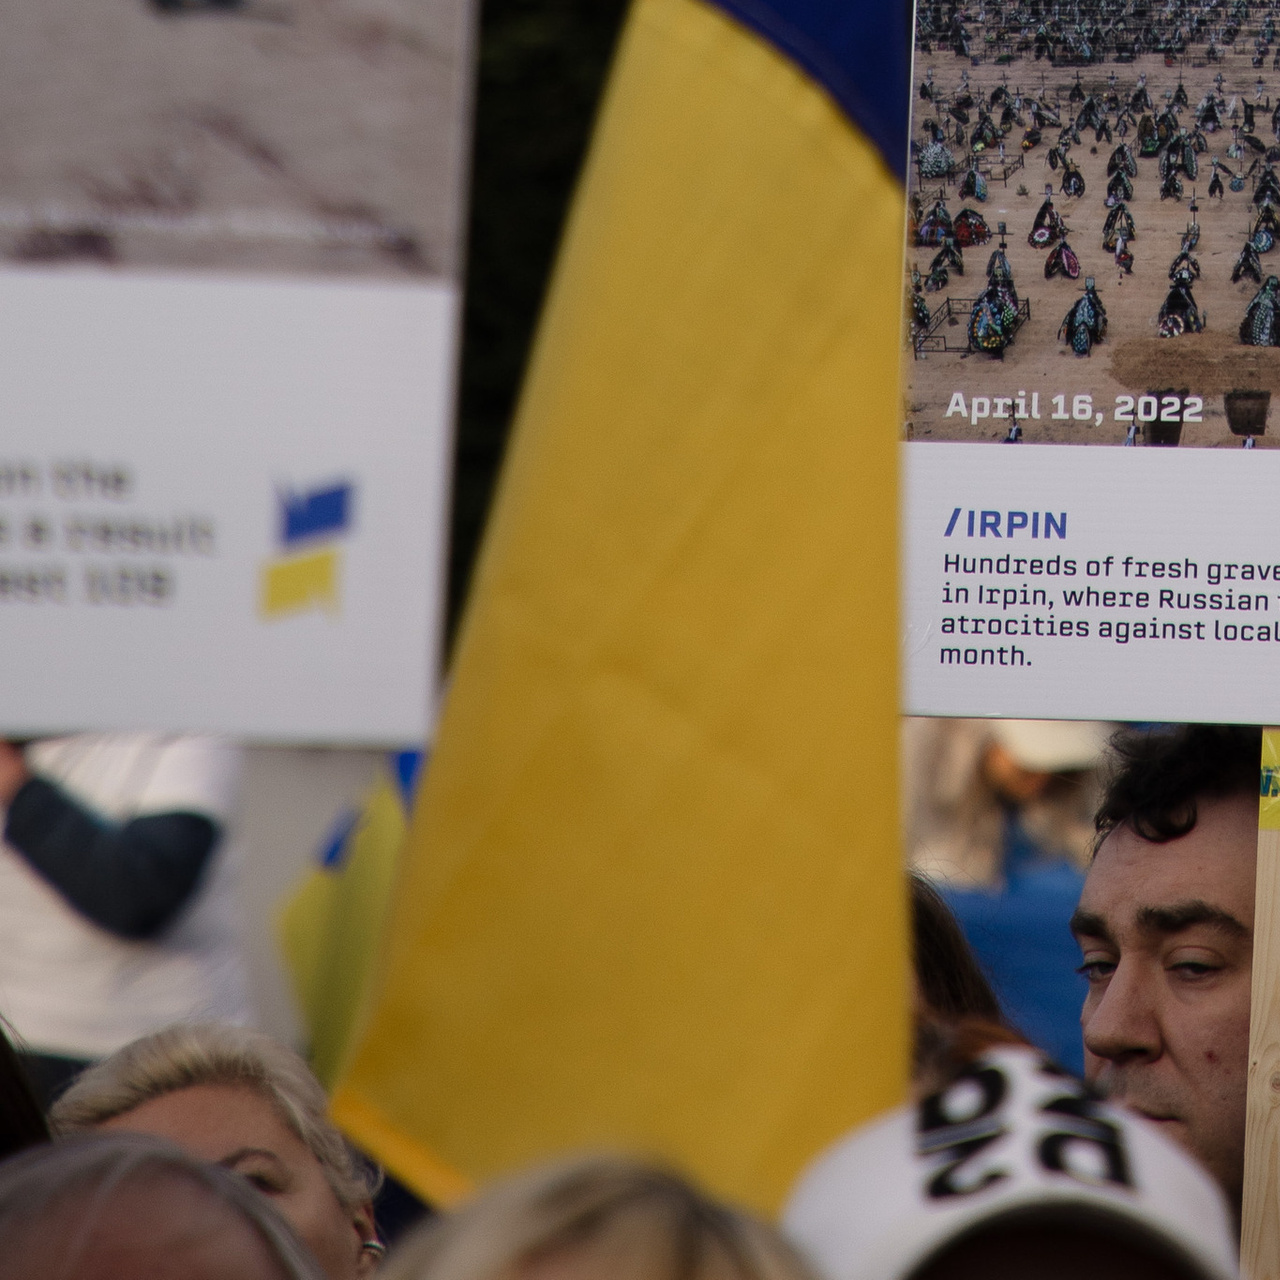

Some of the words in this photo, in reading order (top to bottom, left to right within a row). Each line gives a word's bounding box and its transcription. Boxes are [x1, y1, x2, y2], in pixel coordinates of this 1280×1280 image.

[945, 390, 1041, 425] April
[1051, 394, 1104, 427] 16,
[1113, 395, 1203, 423] 2022
[944, 507, 1067, 539] /IRPIN
[944, 553, 1077, 576] Hundreds
[1086, 555, 1114, 577] of
[1121, 556, 1198, 579] fresh
[942, 581, 969, 604] in
[978, 583, 1054, 611] Irpin,
[1062, 586, 1150, 608] where
[1159, 588, 1269, 611] Russian
[941, 613, 1090, 637] atrocities
[1098, 617, 1206, 644] against
[1214, 619, 1280, 642] local
[940, 645, 1032, 666] month.
